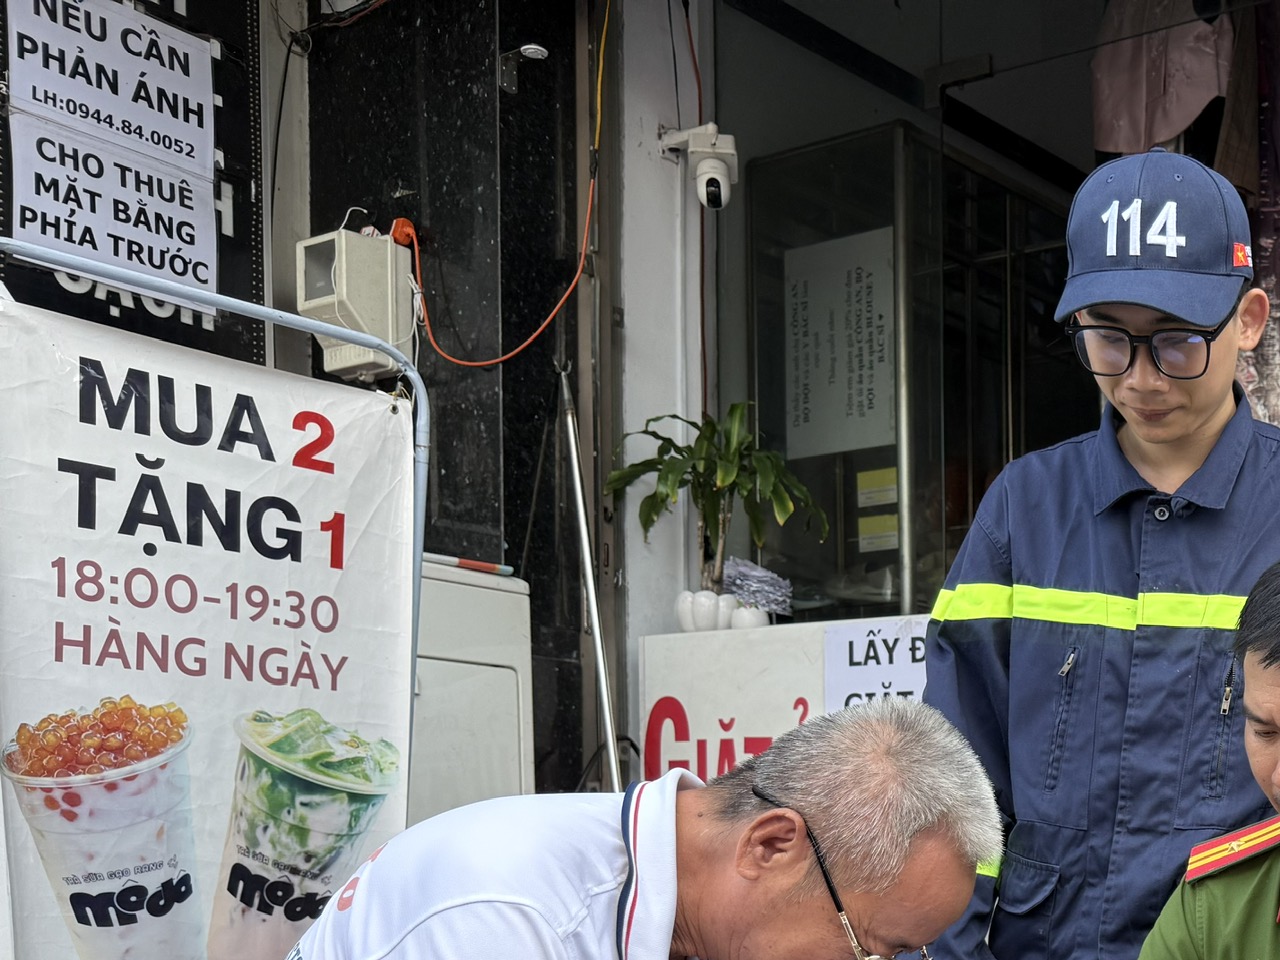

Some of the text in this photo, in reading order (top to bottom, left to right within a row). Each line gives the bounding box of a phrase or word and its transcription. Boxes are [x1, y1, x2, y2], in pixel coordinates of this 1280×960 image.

[17, 31, 119, 96] PHẢN
[131, 71, 204, 129] ÁNH
[120, 24, 190, 78] CẦN
[32, 85, 196, 159] LH:0944.84.0052
[34, 172, 102, 214] MẶT
[113, 198, 196, 246] BẰNG
[36, 137, 104, 179] CHO
[113, 161, 194, 211] THUÊ
[19, 205, 209, 285] PHÍA TRƯỚC
[1101, 198, 1186, 258] 114
[854, 308, 863, 344] CÔNG
[79, 356, 335, 474] MUA 2
[866, 388, 876, 410] ĐỘI
[57, 453, 346, 570] TẶNG 1
[51, 556, 339, 633] 18:00-19:30
[54, 616, 348, 691] HÀNG NGÀY
[849, 629, 899, 667] LẤY
[134, 861, 164, 875] RANG
